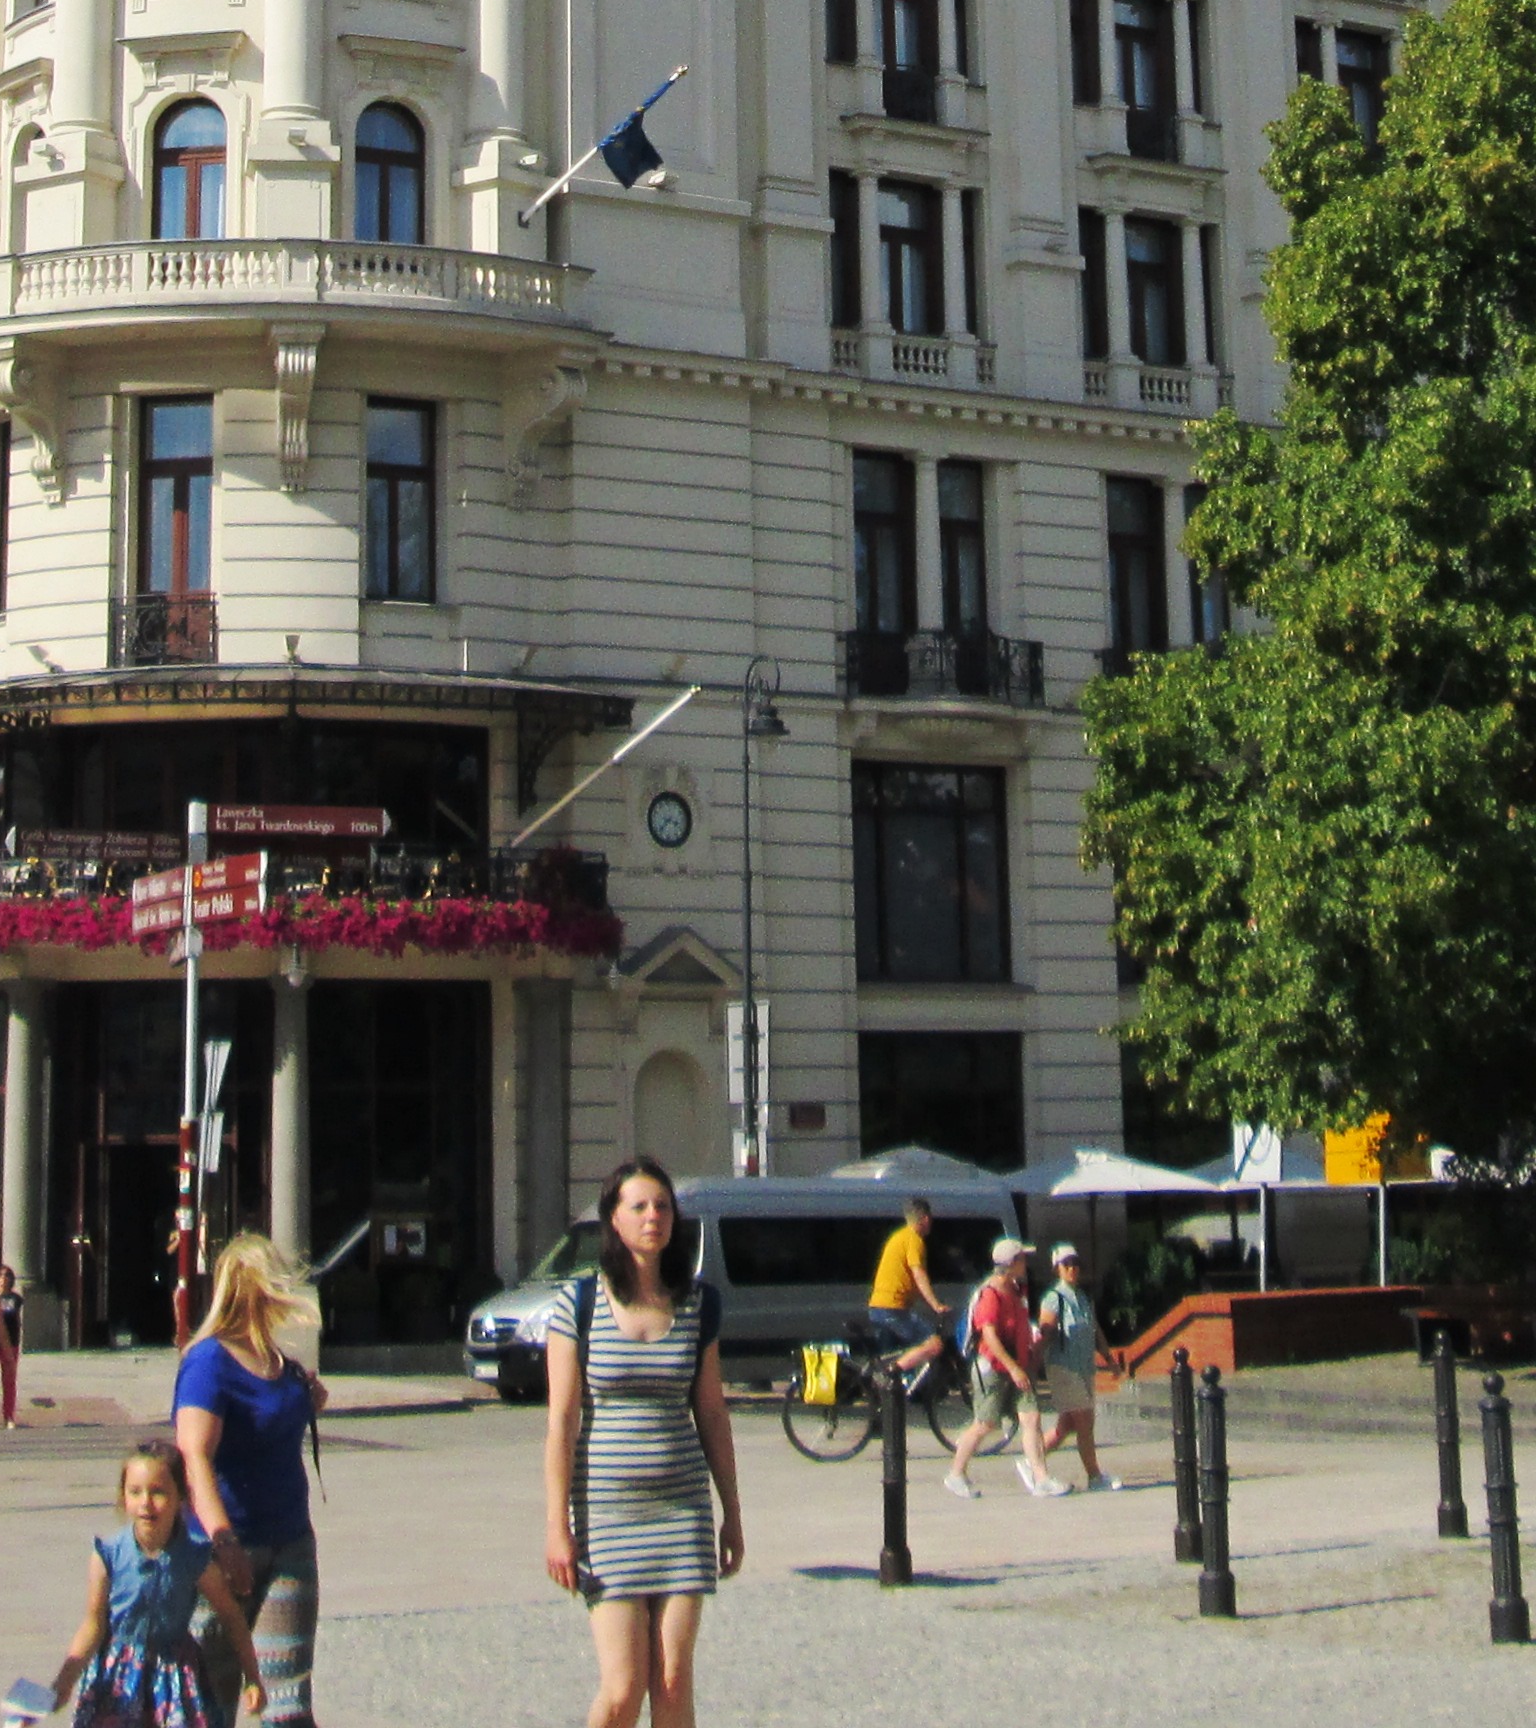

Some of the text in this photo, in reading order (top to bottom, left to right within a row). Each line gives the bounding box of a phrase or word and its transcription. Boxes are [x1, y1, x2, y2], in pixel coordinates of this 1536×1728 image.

[234, 820, 256, 832] Jana
[260, 820, 336, 834] Twardowskiego
[350, 822, 379, 833] 100m
[211, 893, 233, 915] Polski
